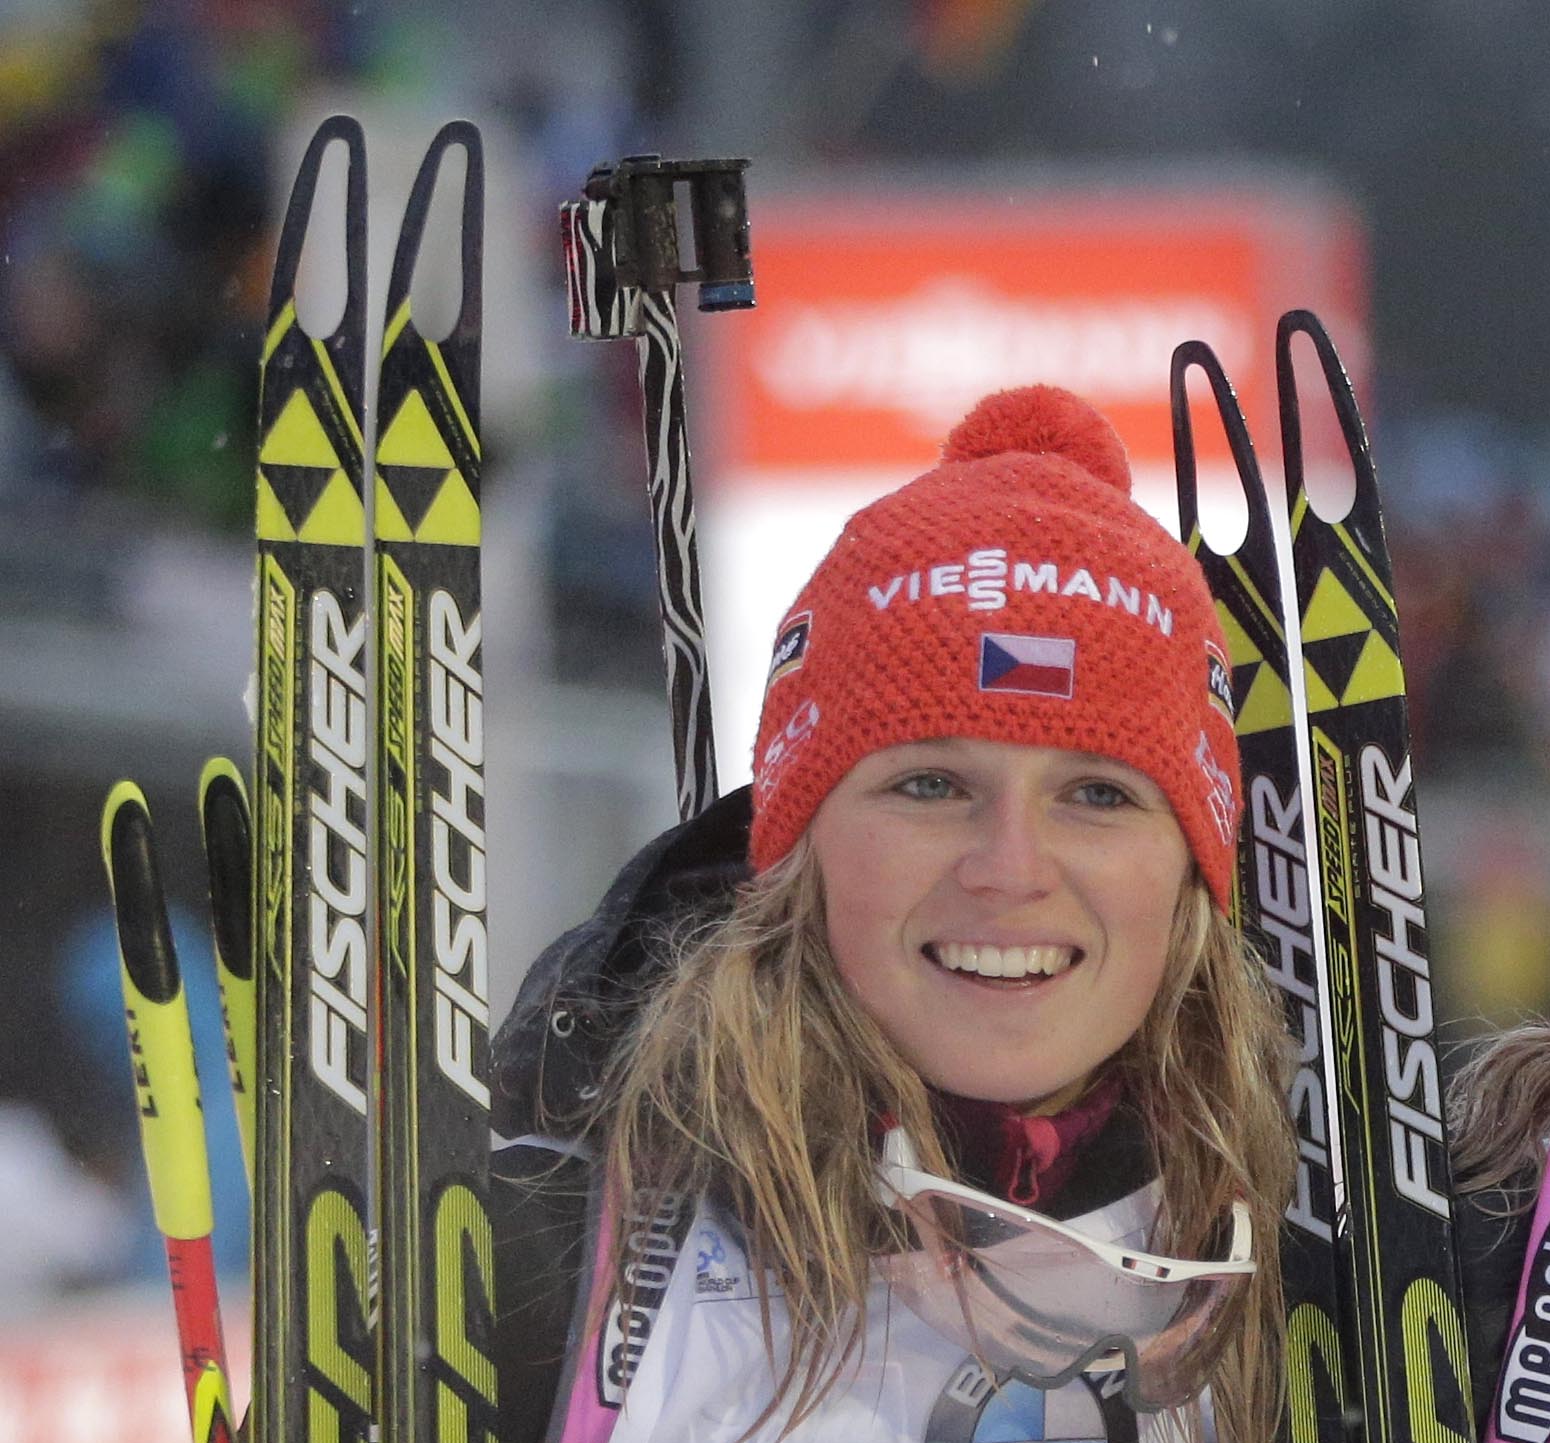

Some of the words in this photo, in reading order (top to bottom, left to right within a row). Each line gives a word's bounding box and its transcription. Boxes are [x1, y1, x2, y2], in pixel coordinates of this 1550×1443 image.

[868, 548, 1173, 637] VIESSMANN
[311, 588, 367, 1116] FISCHER
[430, 588, 492, 1112] FISCHER
[1359, 741, 1452, 1220] FISCHER
